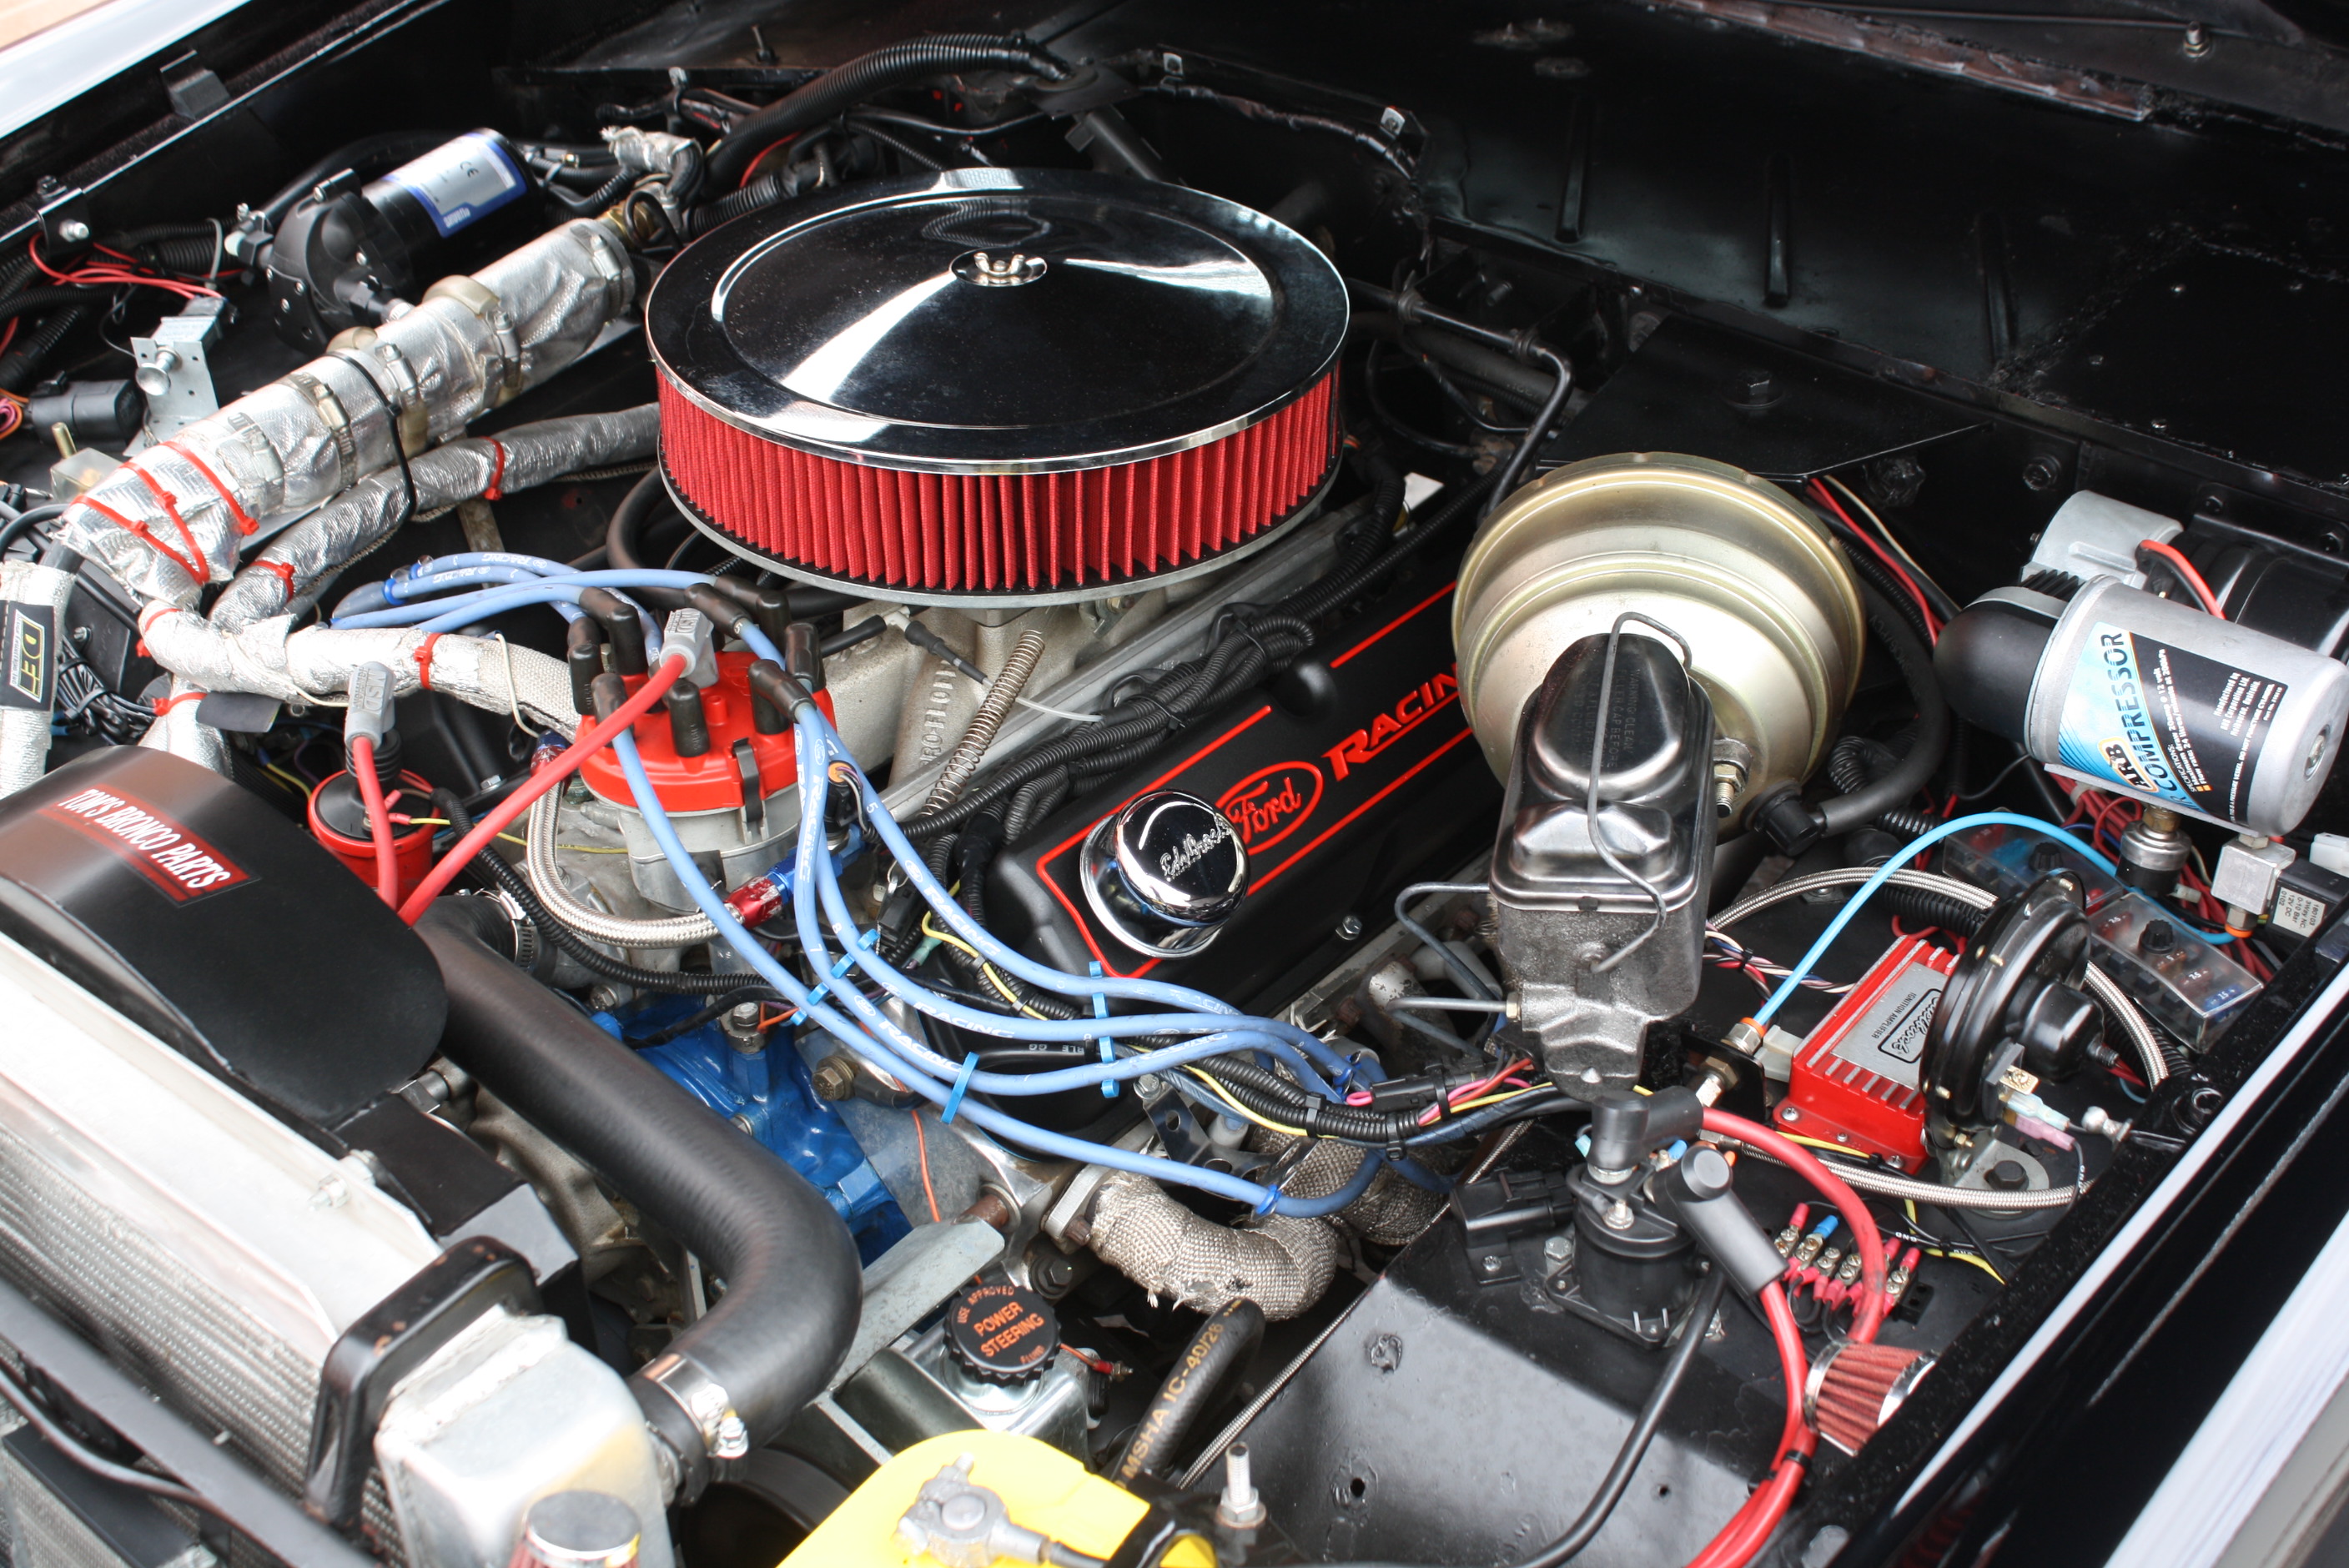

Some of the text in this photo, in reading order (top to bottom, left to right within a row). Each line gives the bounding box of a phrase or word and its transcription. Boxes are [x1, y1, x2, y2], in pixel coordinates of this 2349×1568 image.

[364, 668, 387, 711] MSD
[2100, 632, 2178, 792] COMPRESSOR
[1321, 662, 1460, 782] RACIN
[2171, 731, 2184, 752] draw
[2181, 738, 2191, 749] 24
[2105, 743, 2152, 790] ARB
[867, 802, 879, 814] 5
[1225, 774, 1303, 846] Ford
[58, 788, 232, 889] TOM'S BRONCO PARTS
[923, 884, 1001, 957] RACING
[913, 1002, 1015, 1038] RACING
[1871, 992, 1917, 1039] IGNITION AMPLIFIER
[878, 1019, 964, 1072] RACING
[1895, 1231, 1918, 1243] GND
[957, 1285, 1015, 1324] USE APPROVED
[973, 1301, 1024, 1337] POWER
[980, 1313, 1045, 1358] STEERING
[1121, 1408, 1170, 1480] MSHA
